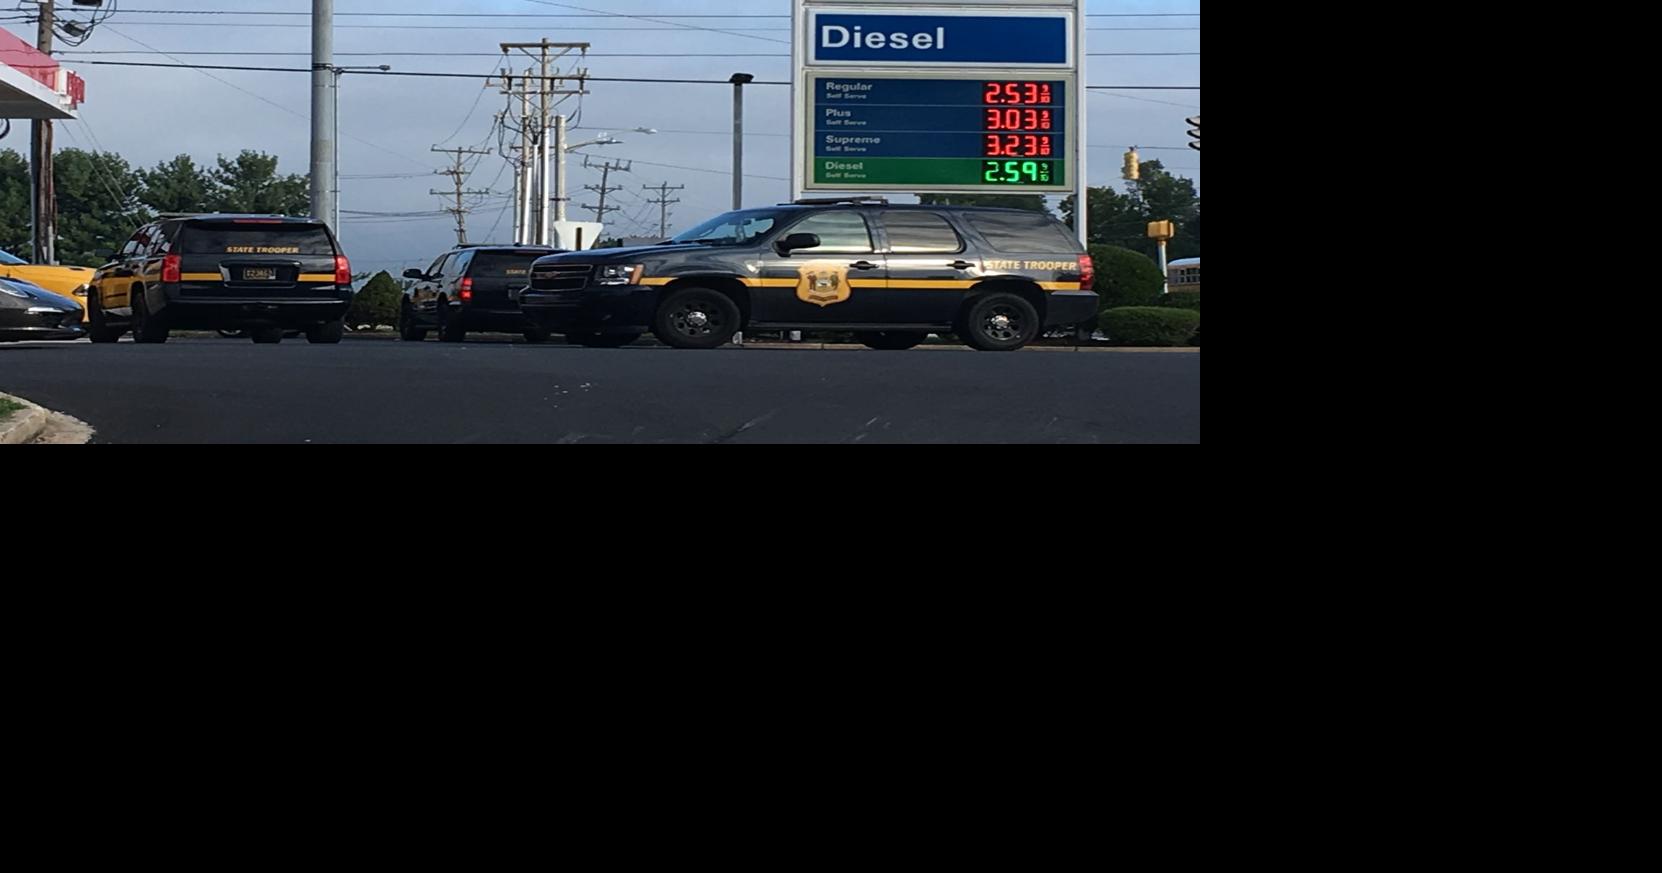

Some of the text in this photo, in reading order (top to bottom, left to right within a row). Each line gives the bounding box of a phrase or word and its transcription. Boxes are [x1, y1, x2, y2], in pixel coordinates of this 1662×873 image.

[822, 25, 944, 49] Diesel
[826, 82, 872, 92] Regular
[986, 83, 1037, 104] 2.53
[825, 108, 851, 117] Plus
[987, 109, 1037, 130] 3.03
[825, 135, 880, 145] Supreme
[987, 135, 1037, 156] 3.23
[825, 161, 863, 170] Diesel
[985, 161, 1037, 182] 2.59
[986, 260, 1077, 271] STATE TROOPER
